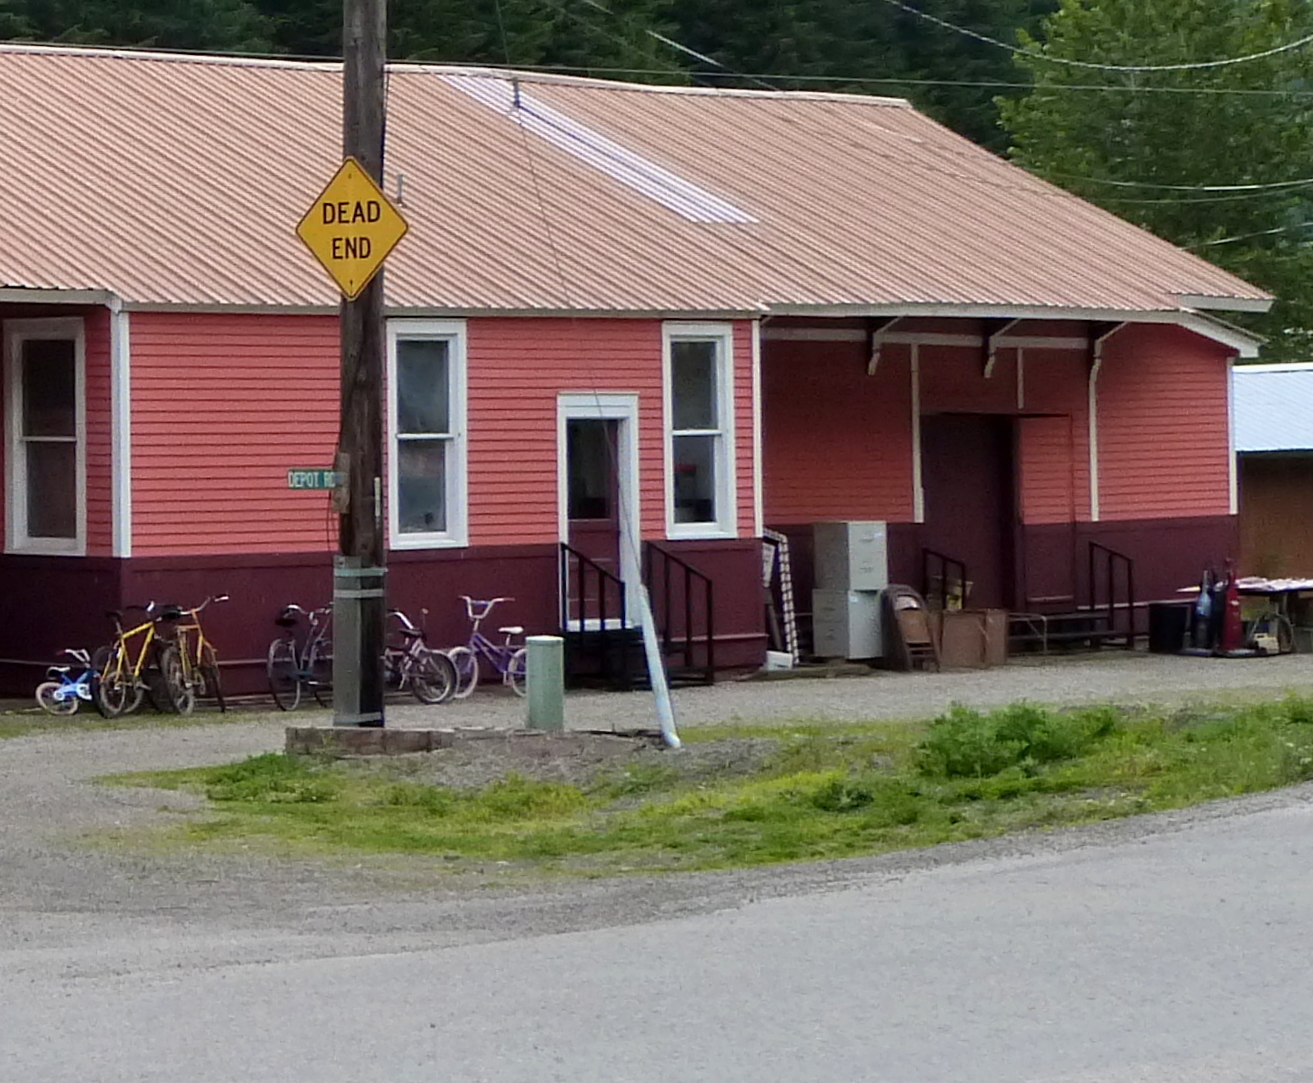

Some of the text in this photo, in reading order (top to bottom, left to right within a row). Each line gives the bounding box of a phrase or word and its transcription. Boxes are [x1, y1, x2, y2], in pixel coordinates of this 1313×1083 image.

[322, 200, 381, 225] DEAD
[331, 236, 372, 260] END
[288, 471, 319, 487] DEPOT
